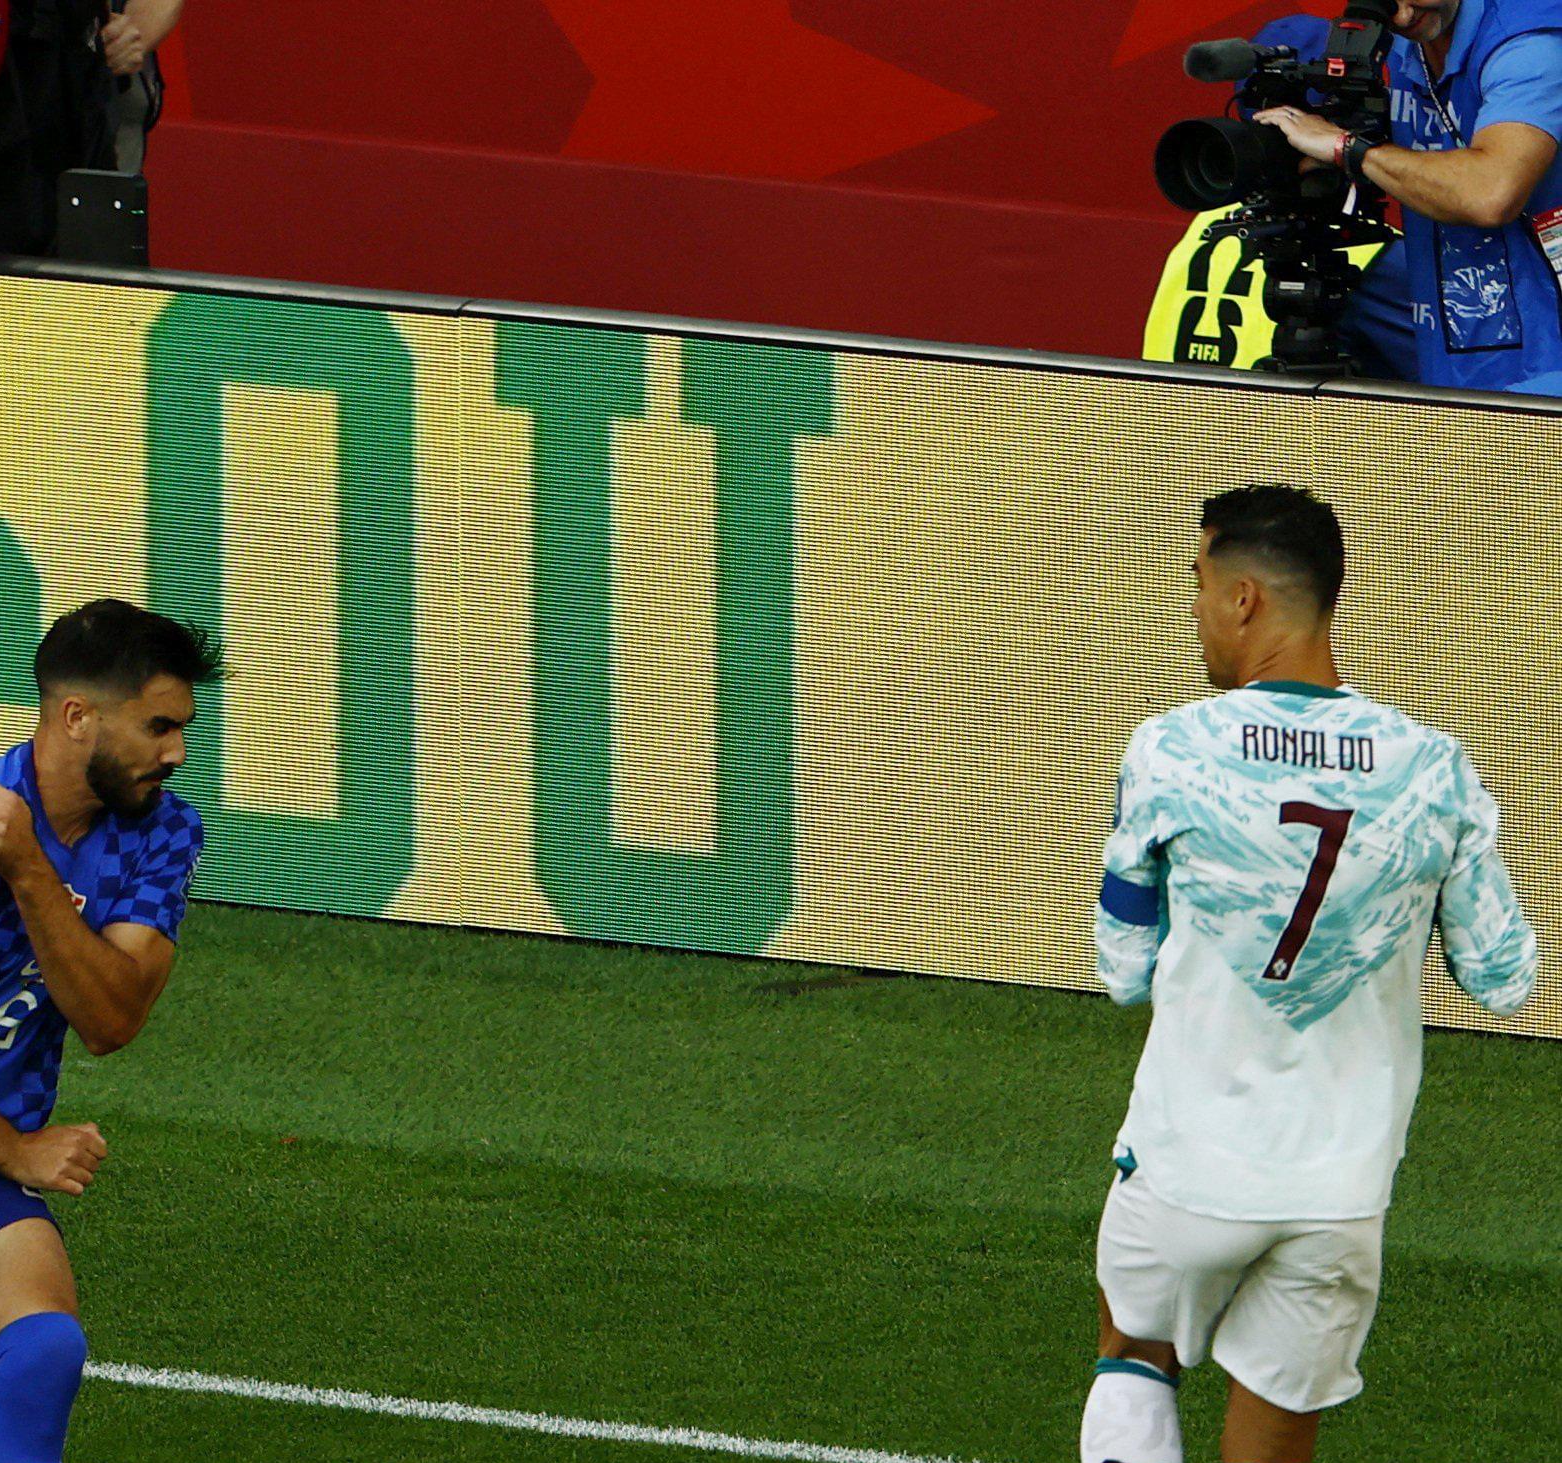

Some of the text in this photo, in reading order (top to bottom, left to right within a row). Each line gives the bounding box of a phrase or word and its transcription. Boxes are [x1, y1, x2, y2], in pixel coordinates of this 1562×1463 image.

[1188, 342, 1220, 362] FIFA
[1243, 724, 1374, 773] RONALDO
[1261, 800, 1355, 982] 7
